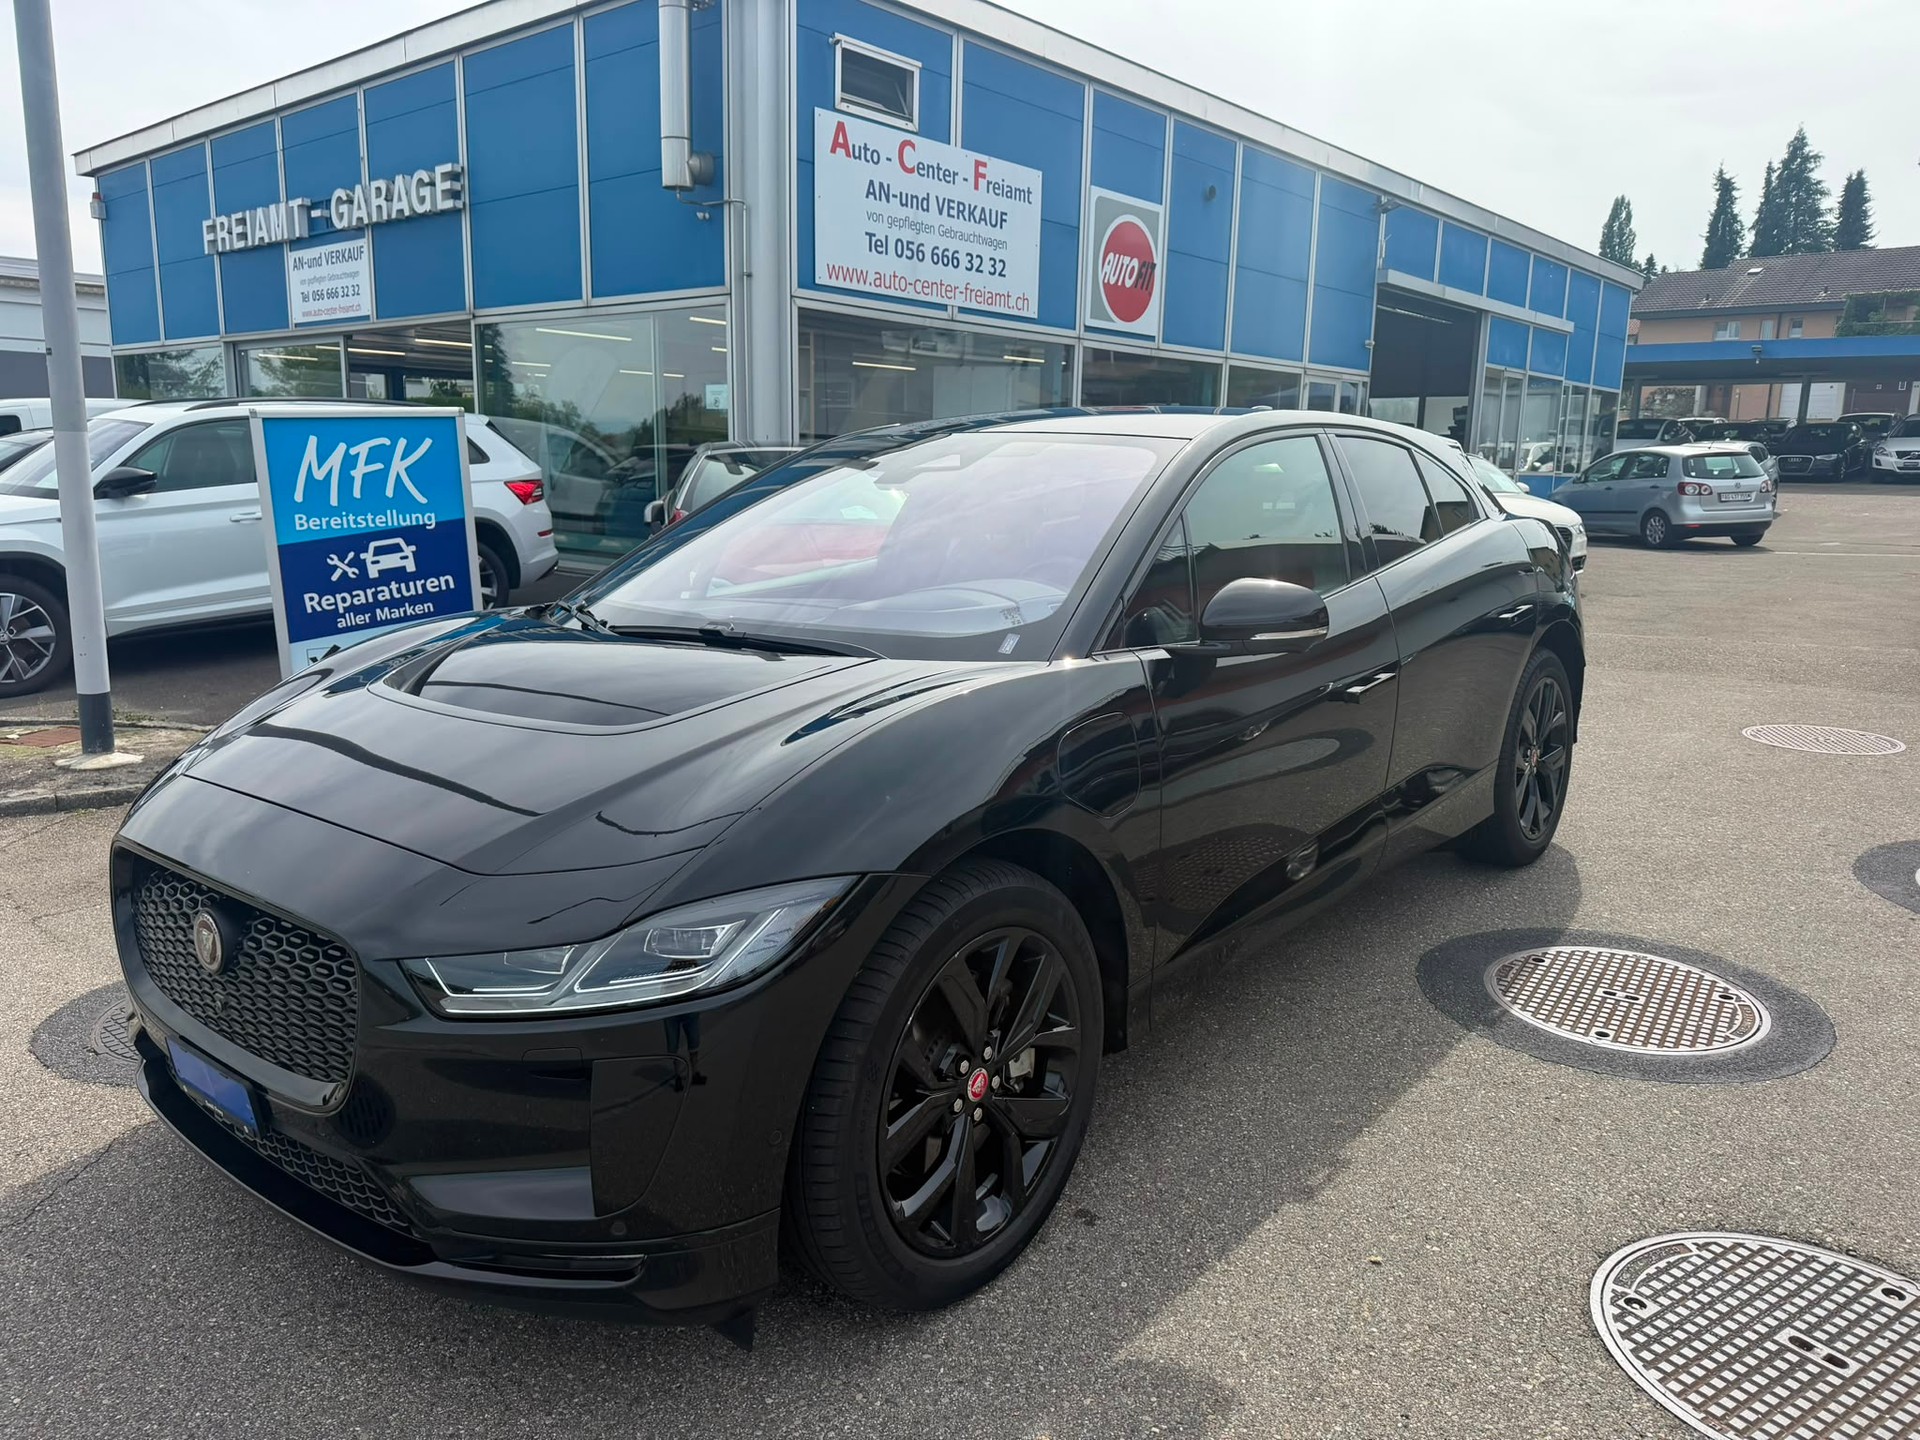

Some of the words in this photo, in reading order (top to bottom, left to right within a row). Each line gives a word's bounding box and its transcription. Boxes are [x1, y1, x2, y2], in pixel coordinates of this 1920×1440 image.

[829, 120, 881, 165] Auto
[897, 139, 959, 185] Center
[973, 159, 1033, 204] Freiamt
[865, 179, 930, 213] AN-und
[935, 195, 1008, 230] VERKAUF
[866, 211, 884, 223] von
[887, 213, 935, 236] gepflegten
[938, 224, 1008, 251] Gebrauchtwagen
[293, 253, 322, 271] AN-und
[324, 246, 364, 265] VERKAUF
[865, 231, 889, 256] Tel
[894, 238, 925, 263] 056
[930, 245, 960, 270] 666
[965, 252, 984, 274] 32
[988, 258, 1007, 278] 32
[301, 292, 309, 302] Tel
[312, 290, 325, 301] 056
[326, 287, 339, 299] 666
[341, 286, 350, 297] 32
[351, 284, 360, 295] 32
[826, 263, 1030, 312] www.auto-center-freiamt.ch
[294, 434, 433, 506] MFK
[294, 509, 436, 531] Bereitstellung
[303, 573, 455, 614] Reparaturen
[336, 611, 371, 629] aller
[376, 601, 435, 622] Marken
